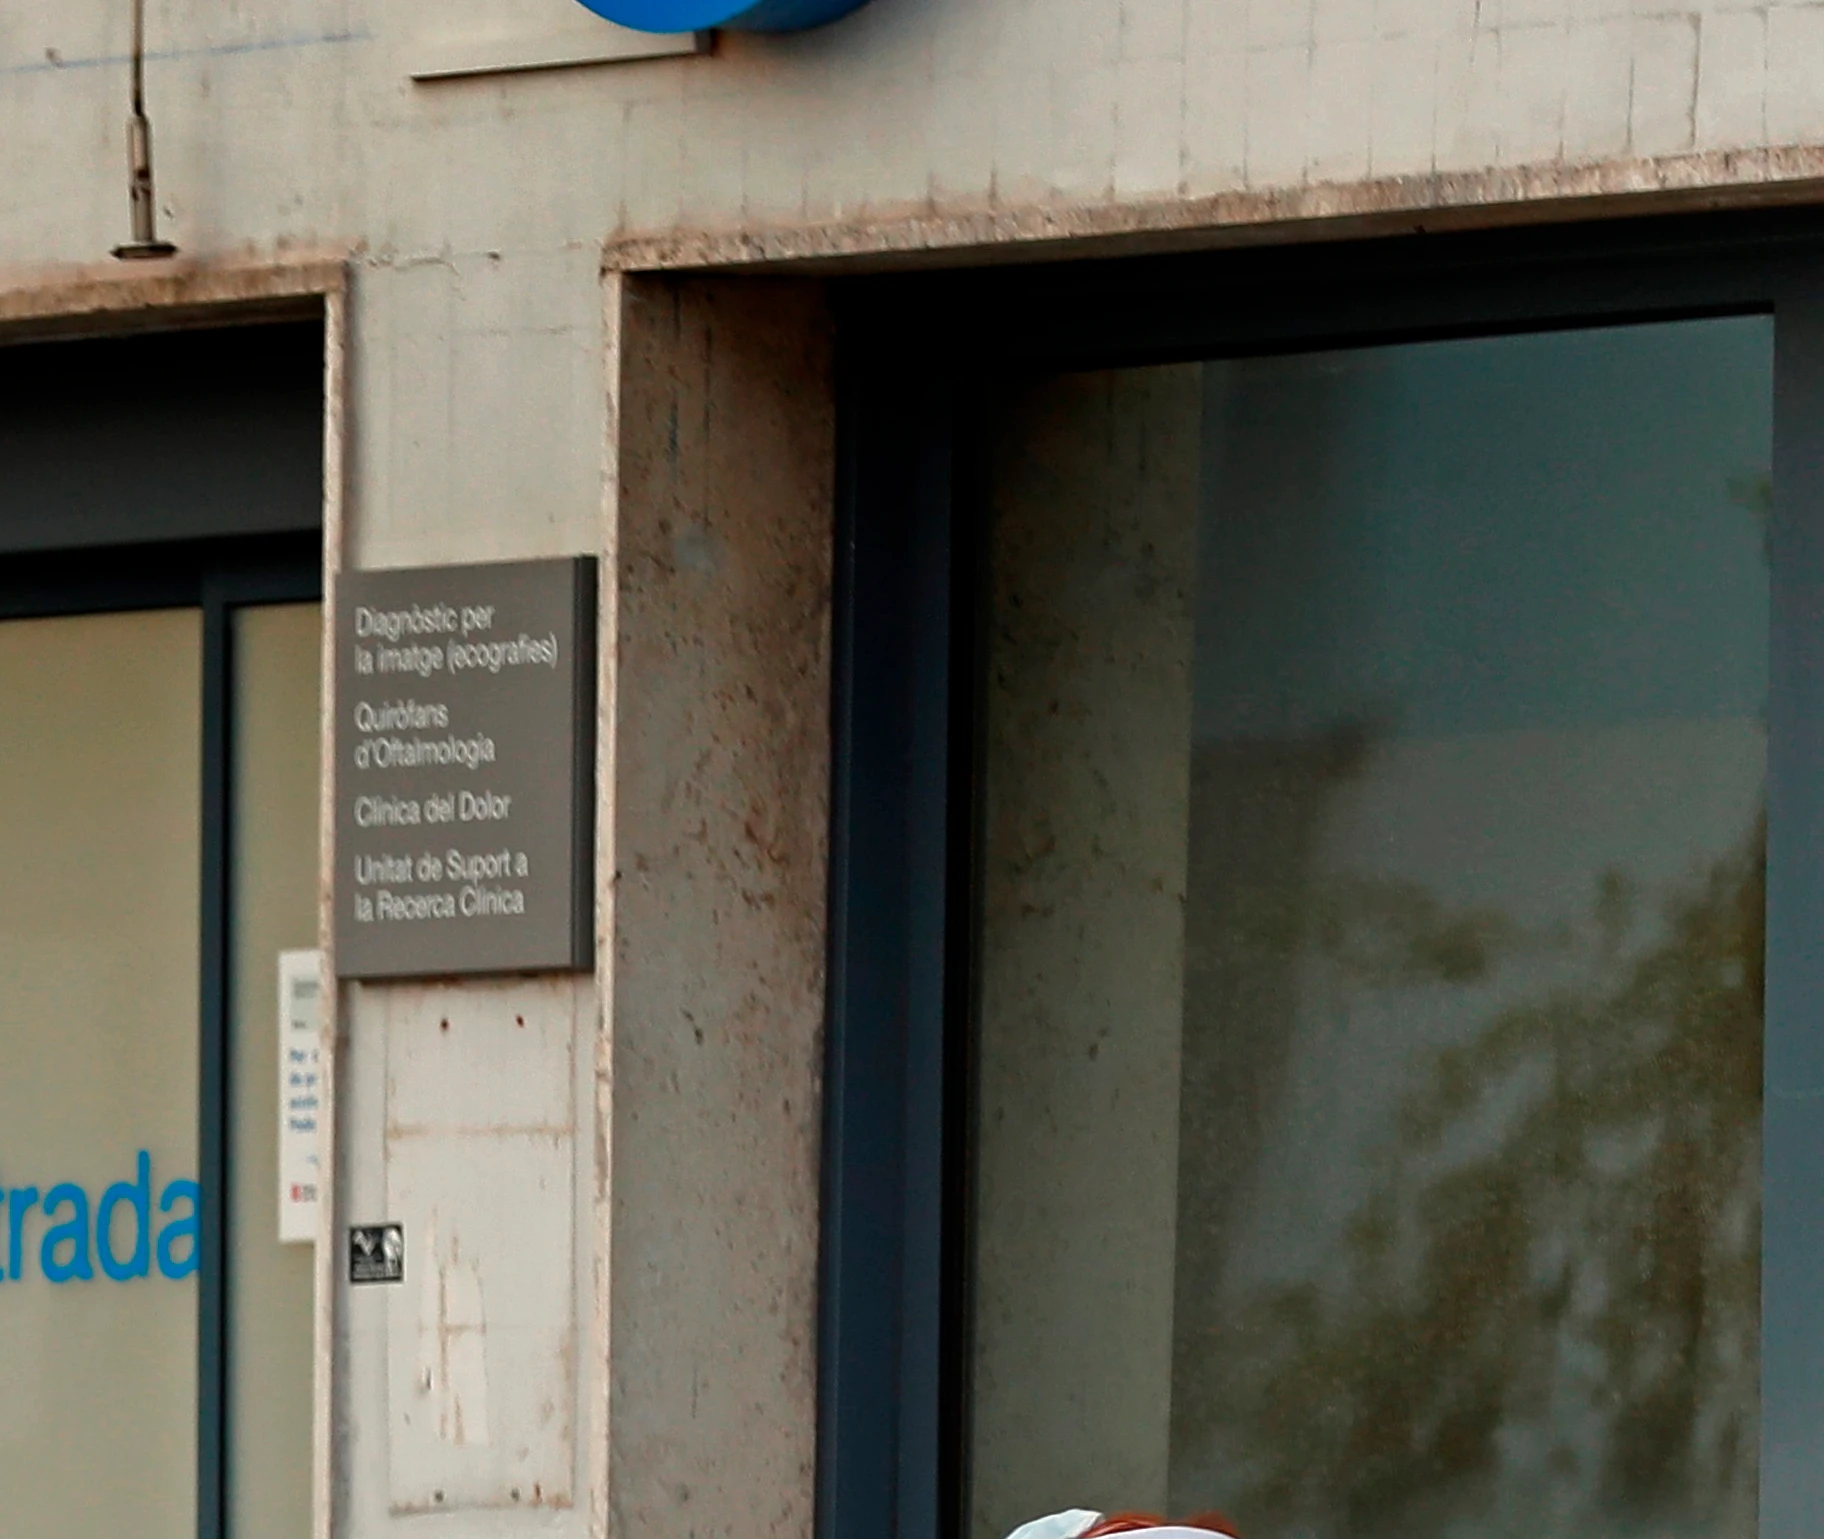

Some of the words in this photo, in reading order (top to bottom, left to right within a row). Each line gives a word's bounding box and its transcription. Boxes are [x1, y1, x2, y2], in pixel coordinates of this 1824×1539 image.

[460, 605, 496, 637] per
[354, 644, 374, 675] la
[376, 642, 444, 677] imatge
[447, 631, 558, 675] (ecografies)
[423, 792, 455, 823] del
[458, 789, 512, 822] Dolor
[354, 853, 413, 885] Unitat
[416, 851, 443, 882] de
[445, 848, 511, 886] Suport
[514, 852, 529, 877] a
[354, 893, 374, 922] la
[376, 889, 456, 921] Recerca
